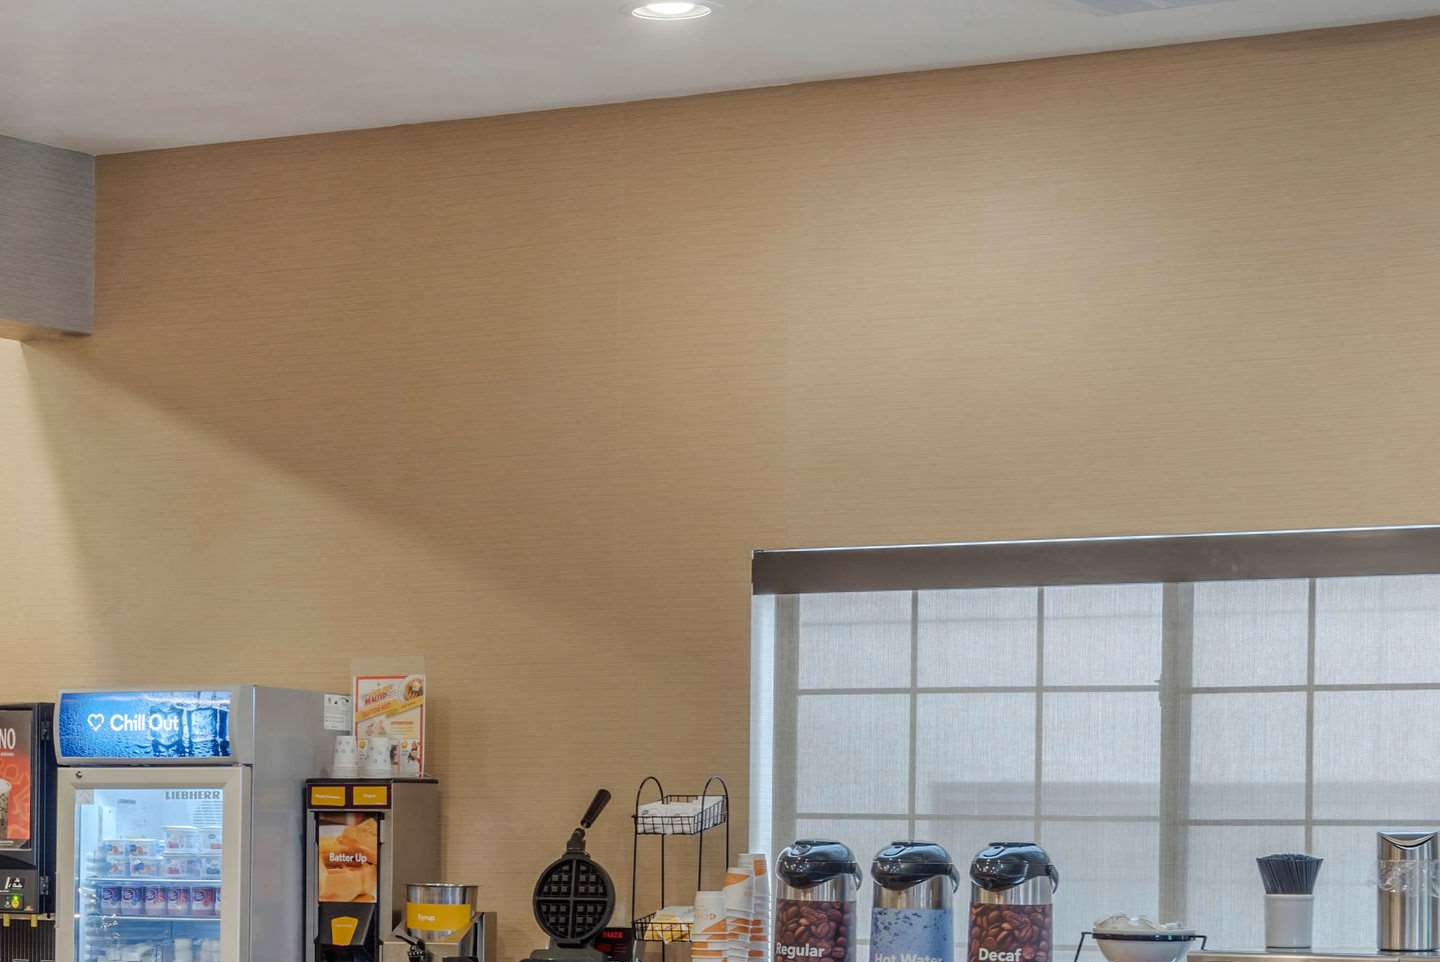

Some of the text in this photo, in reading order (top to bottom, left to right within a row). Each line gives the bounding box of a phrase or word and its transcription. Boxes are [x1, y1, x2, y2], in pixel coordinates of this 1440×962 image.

[110, 713, 180, 732] Chill Out
[165, 790, 221, 800] LIEBHERR
[329, 852, 368, 865] Batter Up
[776, 942, 825, 959] Regular
[978, 948, 1022, 962] Decaf
